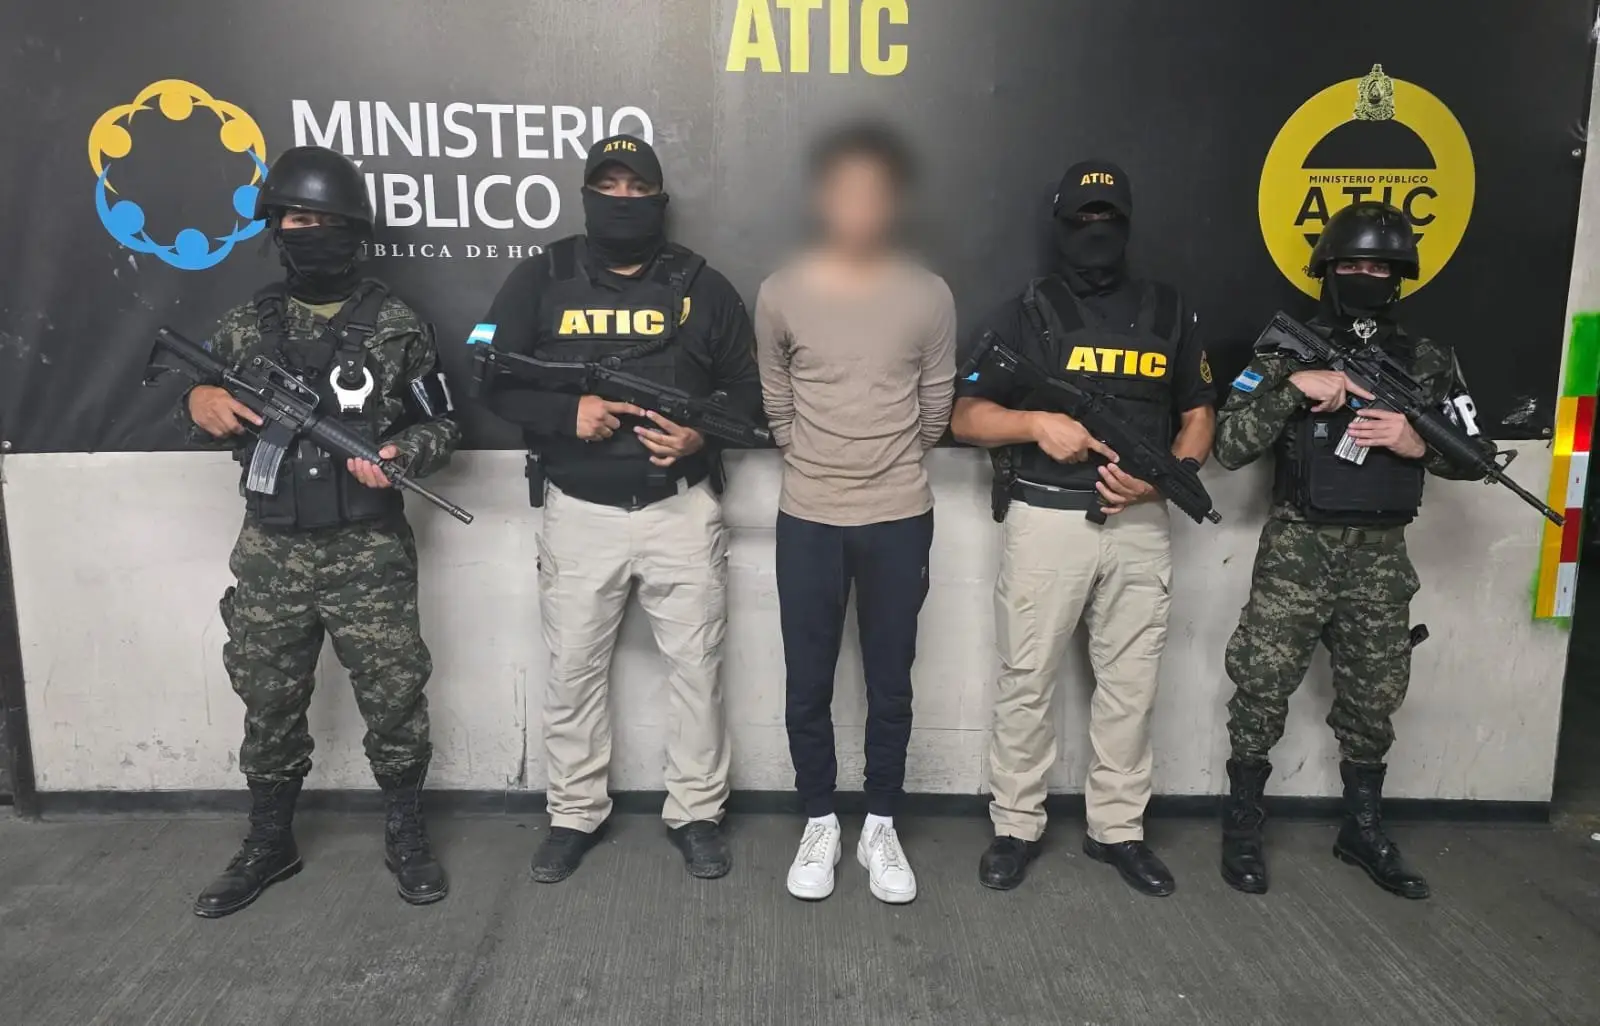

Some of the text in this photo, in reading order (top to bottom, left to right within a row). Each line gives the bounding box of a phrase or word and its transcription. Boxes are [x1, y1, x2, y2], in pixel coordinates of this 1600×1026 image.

[726, 0, 909, 76] ATIC
[292, 100, 654, 159] MINISTERIO
[603, 140, 638, 153] ATIC
[1080, 172, 1114, 186] ATIC
[1309, 173, 1429, 184] MINISTERIO PÚBLICO
[353, 160, 561, 229] BLICO
[360, 240, 452, 258] BLICA
[465, 245, 498, 258] DE
[558, 309, 665, 336] ATIC
[1065, 346, 1167, 378] ATIC
